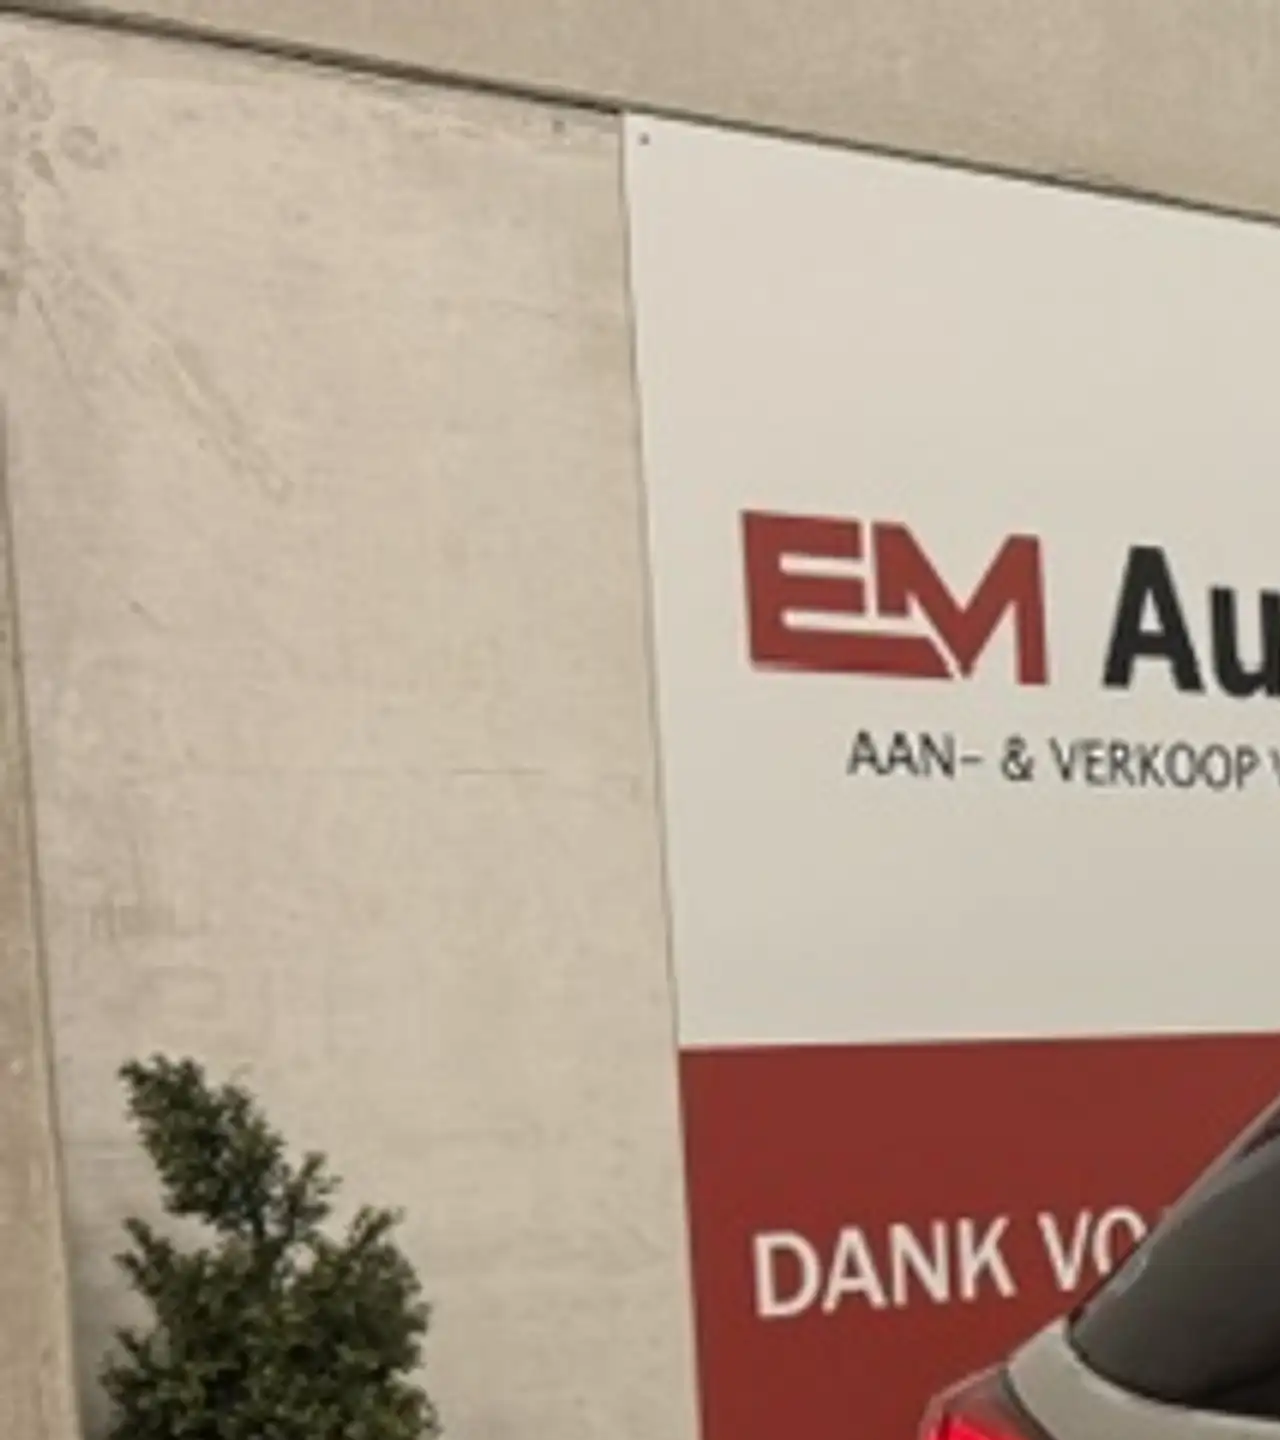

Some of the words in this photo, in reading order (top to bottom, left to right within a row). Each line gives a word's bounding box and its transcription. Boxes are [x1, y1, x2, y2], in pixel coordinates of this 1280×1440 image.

[740, 509, 1048, 685] EM
[846, 727, 985, 781] AAN-
[1000, 733, 1036, 783] &
[1049, 736, 1261, 792] VERKOOP
[753, 1216, 1017, 1318] DANK
